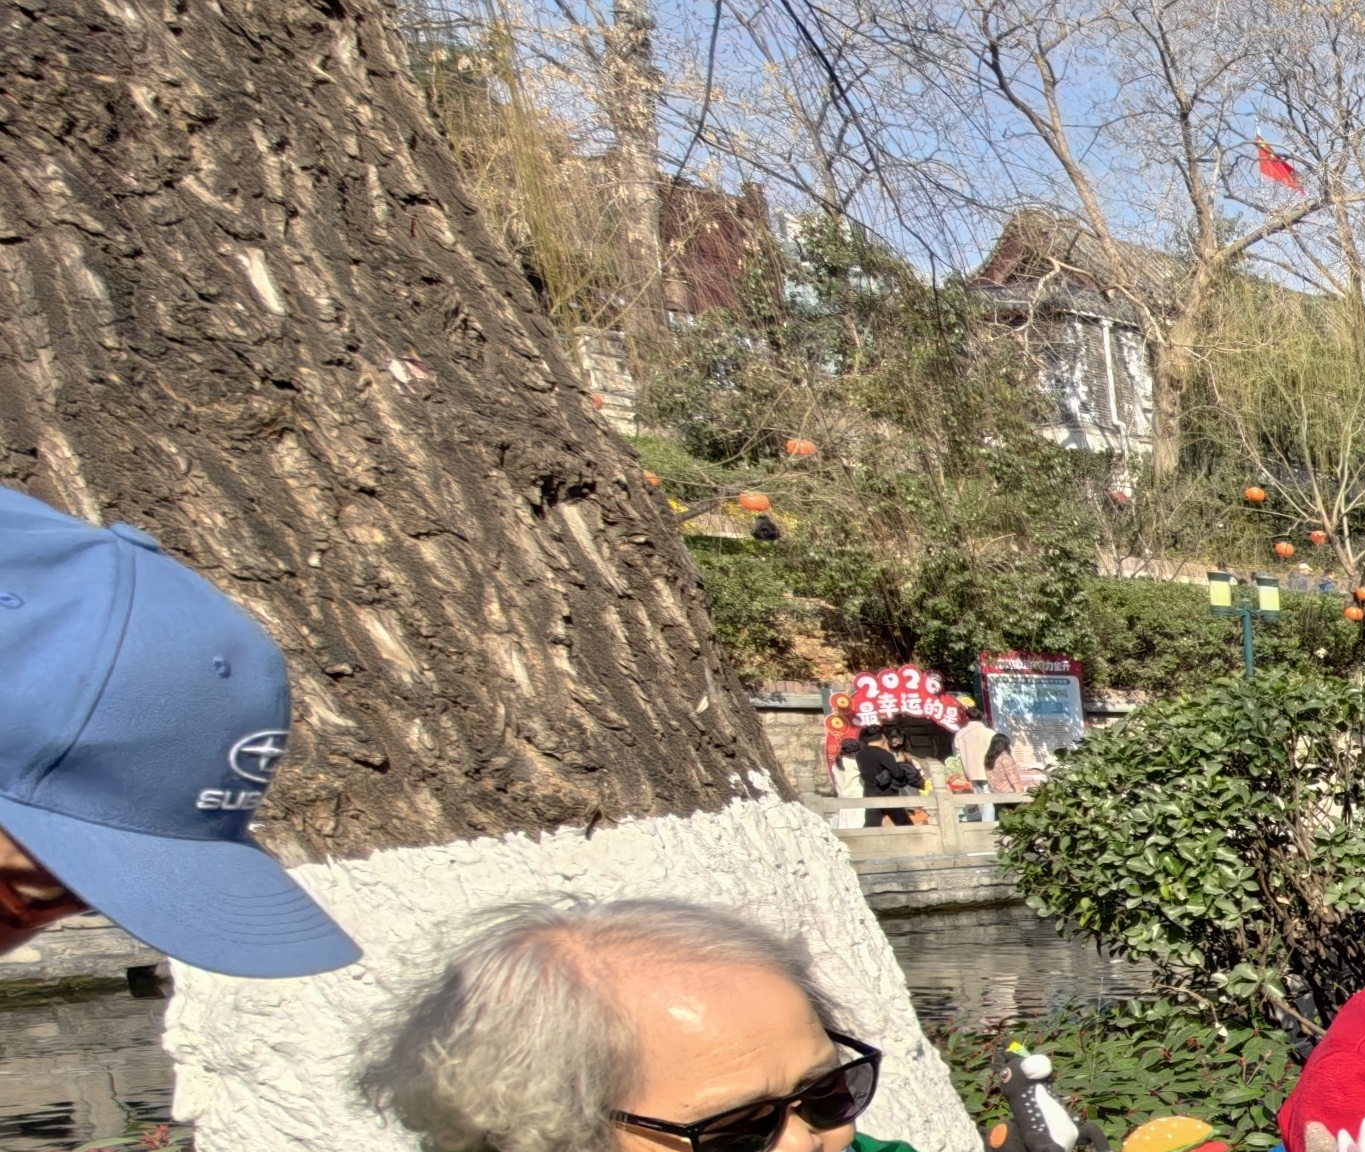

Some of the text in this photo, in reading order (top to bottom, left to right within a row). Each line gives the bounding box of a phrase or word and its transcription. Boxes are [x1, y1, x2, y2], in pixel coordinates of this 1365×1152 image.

[857, 669, 942, 698] 2026
[857, 692, 960, 732] 最幸运的是
